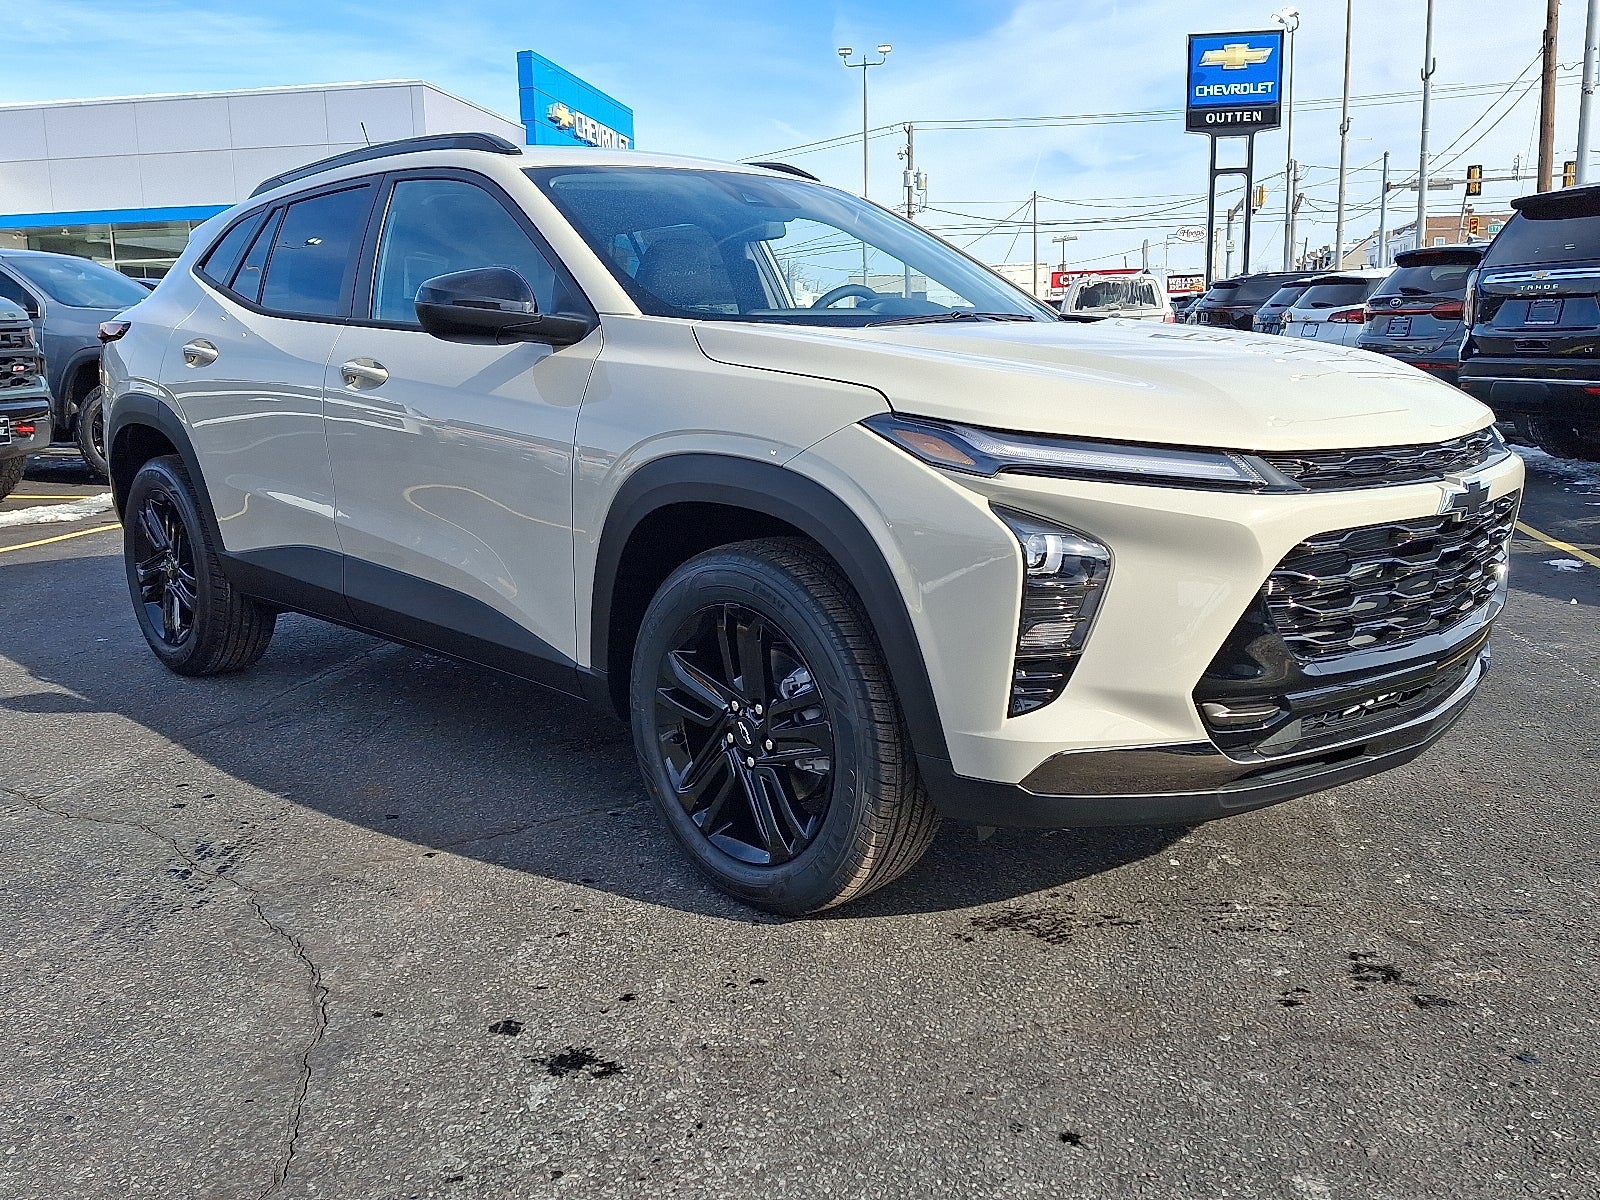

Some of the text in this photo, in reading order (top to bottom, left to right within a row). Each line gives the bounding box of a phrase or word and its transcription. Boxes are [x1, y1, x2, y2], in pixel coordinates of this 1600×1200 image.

[1195, 81, 1275, 97] CHEVROLET
[1205, 110, 1262, 123] OUTTEN
[1520, 283, 1559, 291] TAHOE
